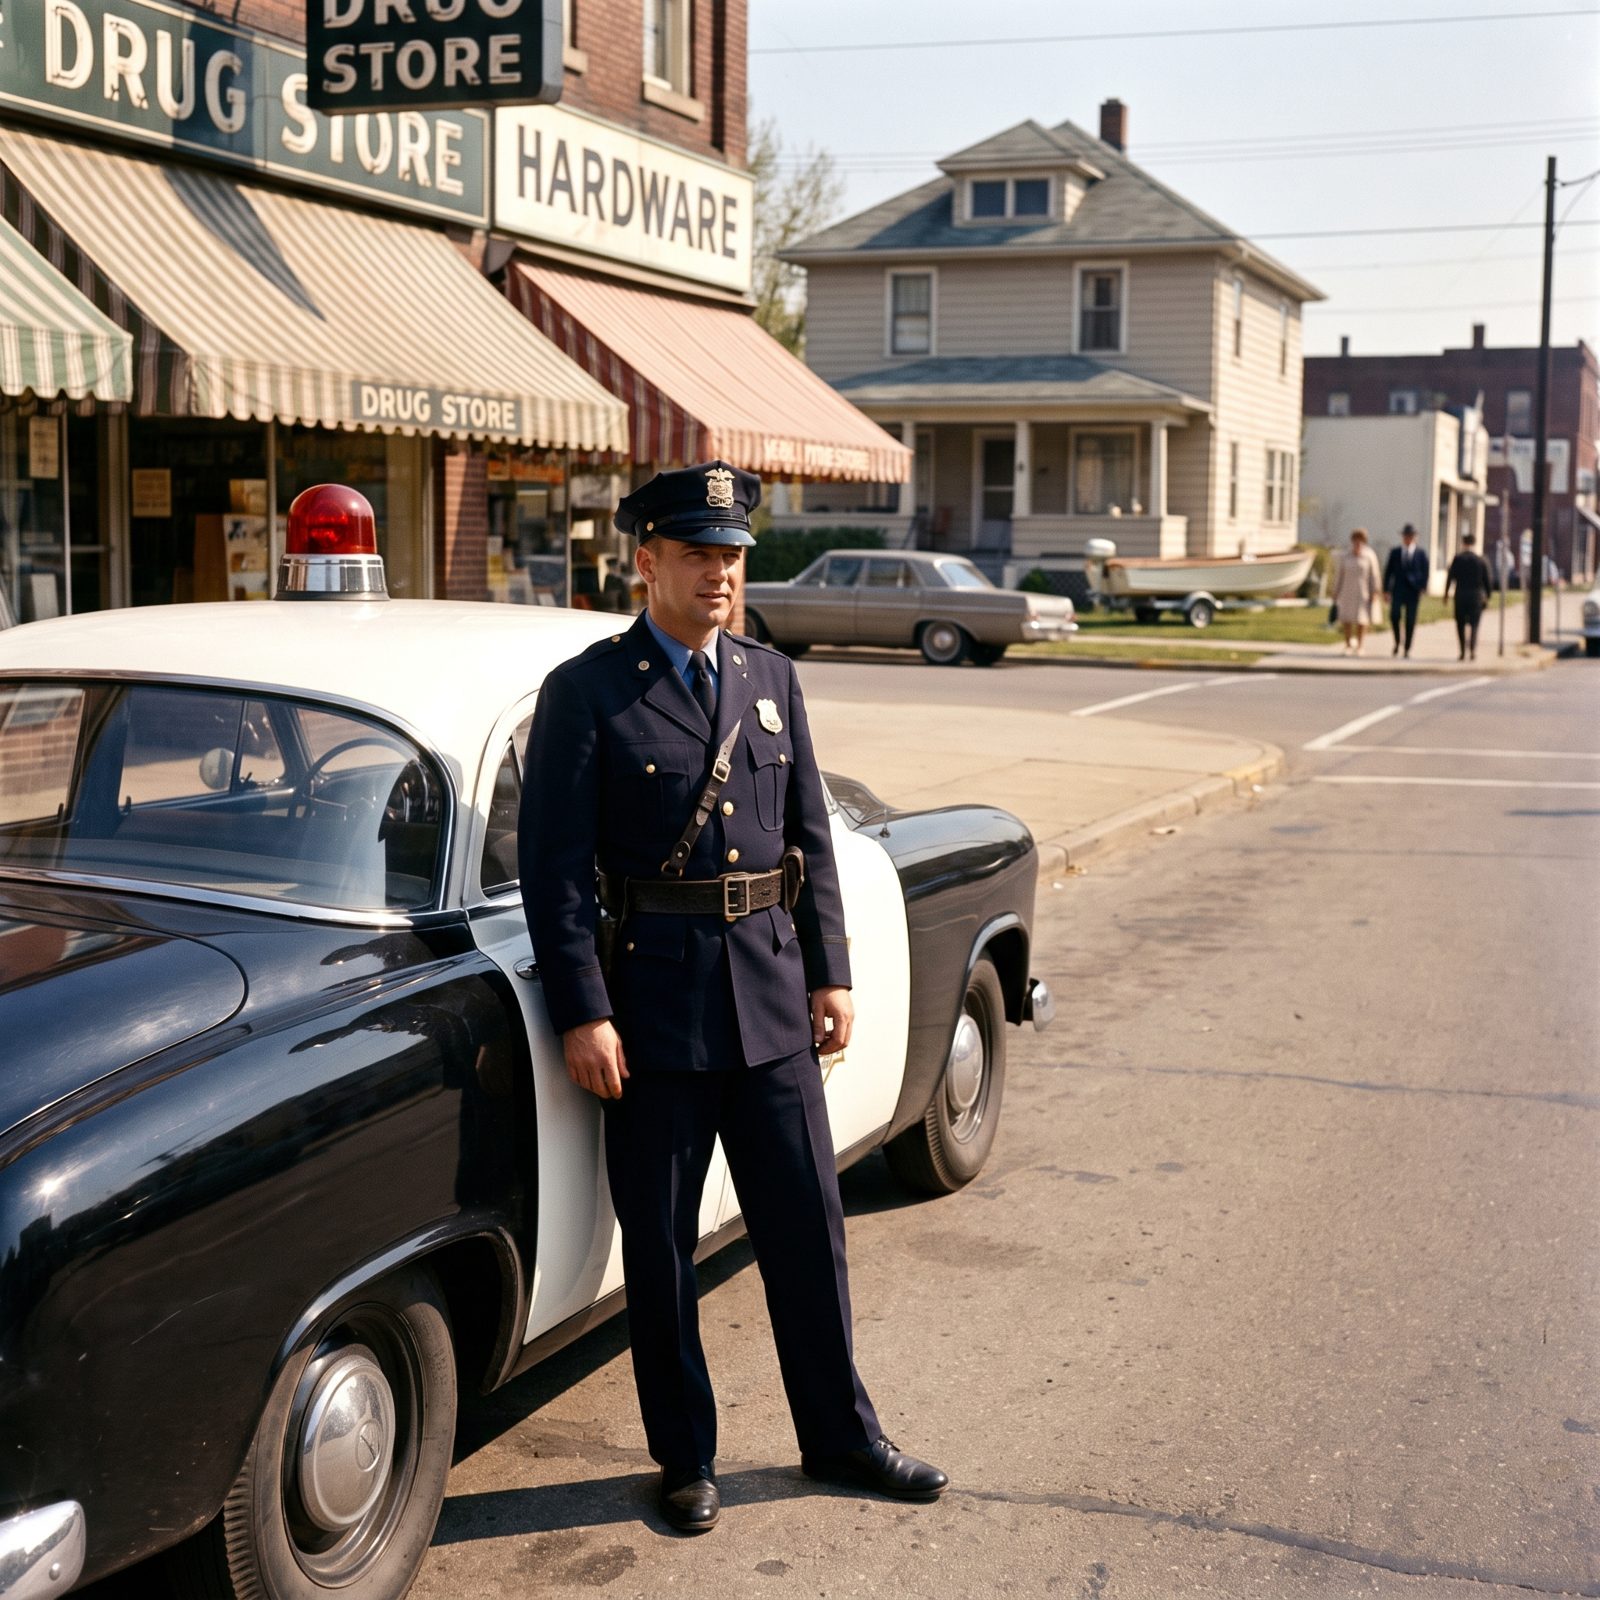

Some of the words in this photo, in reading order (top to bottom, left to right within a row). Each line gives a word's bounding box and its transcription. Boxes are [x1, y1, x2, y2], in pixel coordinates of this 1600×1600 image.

[45, 0, 246, 134] DRUG
[322, 34, 522, 94] STORE
[518, 124, 737, 259] HARDWARE
[360, 385, 432, 422] DRUG
[441, 395, 517, 430] STORE
